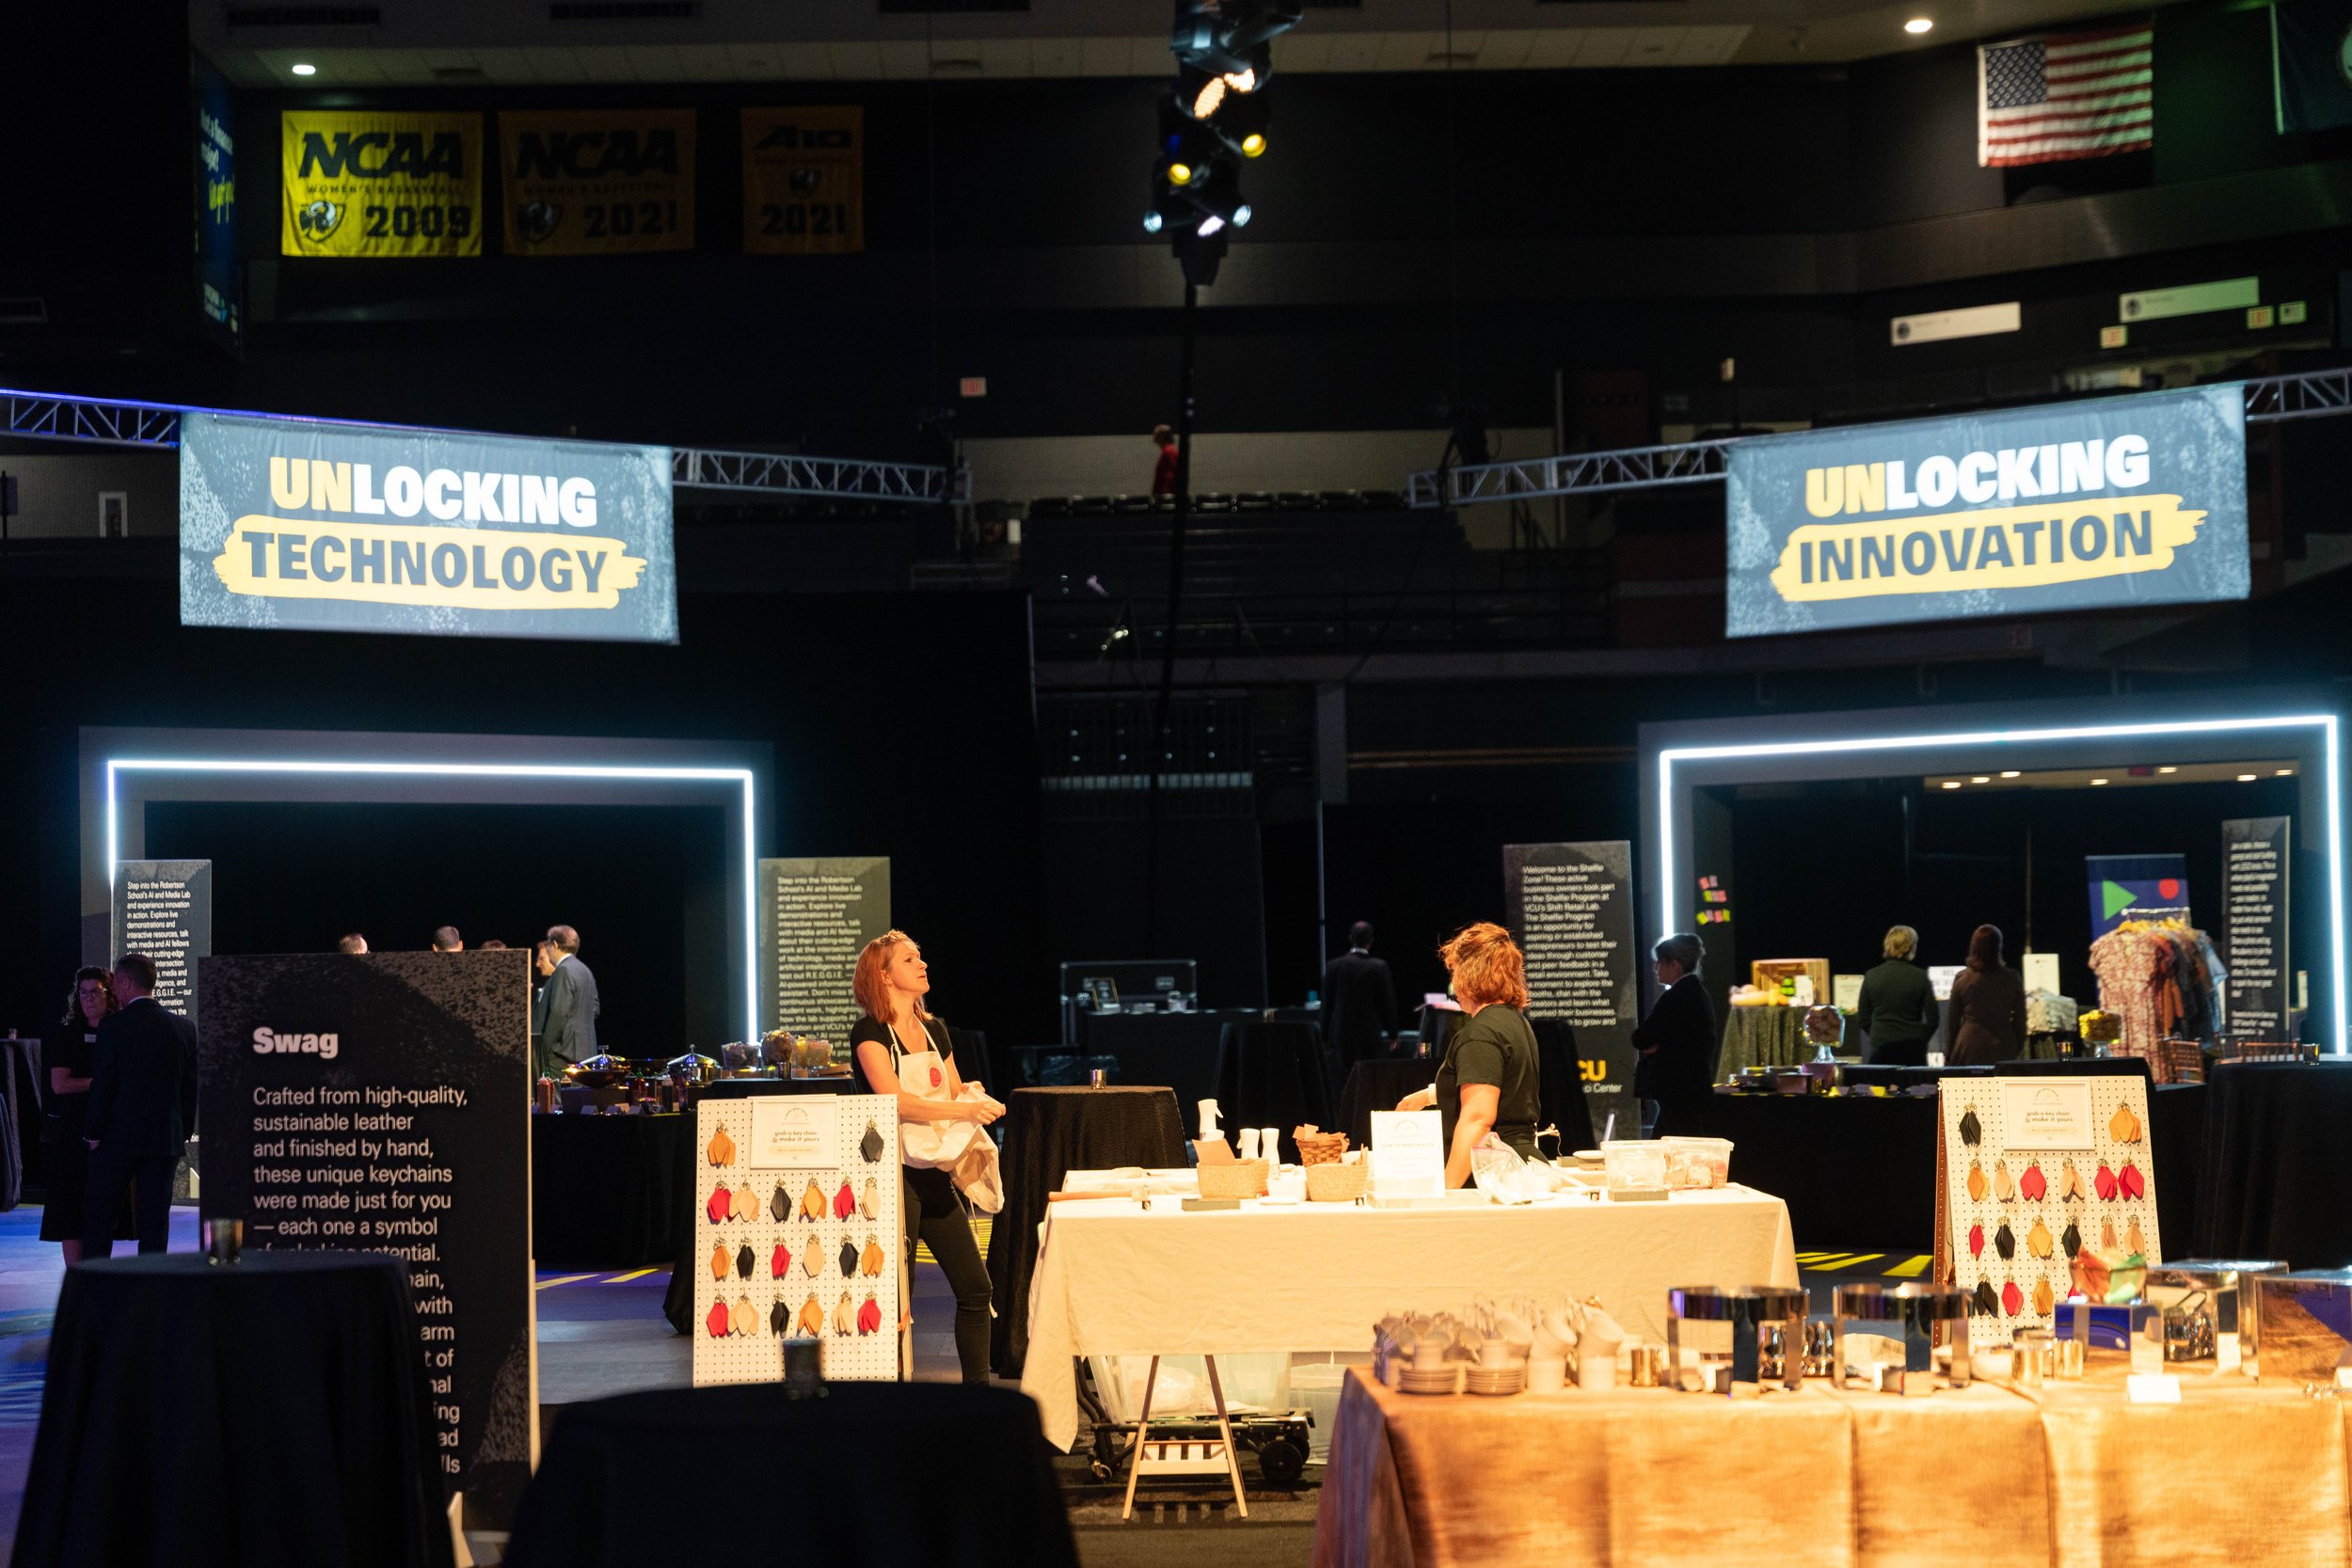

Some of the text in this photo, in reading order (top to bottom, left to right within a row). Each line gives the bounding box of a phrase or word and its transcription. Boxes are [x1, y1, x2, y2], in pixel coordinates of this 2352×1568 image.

[297, 132, 465, 179] NCAA
[516, 129, 678, 179] NCAA
[365, 205, 472, 239] 2009
[584, 201, 679, 239] 2021
[761, 204, 848, 236] 2021
[1804, 434, 2151, 518] UNLOCKING
[269, 456, 598, 528] UNLOCKING
[1798, 509, 2153, 584] INNOVATION
[241, 531, 609, 594] TECHNOLOGY
[1522, 866, 1556, 875] Welcome
[1566, 864, 1579, 874] the
[1579, 863, 1604, 873] Shelfie
[1523, 874, 1588, 884] Zone! These active
[127, 881, 139, 891] Step
[160, 880, 185, 889] Robertson
[127, 891, 148, 900] School's
[154, 891, 165, 899] and
[165, 891, 181, 899] Media
[181, 890, 191, 898] Lab
[1523, 884, 1555, 894] business
[1583, 883, 1599, 892] took
[1600, 883, 1615, 893] part
[127, 900, 190, 911] and experience innovation
[1533, 894, 1544, 902] the
[1545, 894, 1570, 902] Shelfie
[1570, 893, 1601, 903] Program
[1601, 893, 1610, 901] at
[127, 921, 166, 929] demonstrations
[151, 911, 168, 920] Explore
[1525, 911, 1595, 923] The Shelfie Program
[127, 929, 189, 940] interactive resources, talk
[139, 941, 154, 949] media
[155, 940, 165, 948] and
[171, 940, 190, 948] fellows
[153, 949, 185, 959] cutting-edge
[155, 959, 184, 968] intersection
[161, 969, 177, 977] media
[178, 968, 187, 976] and
[252, 1025, 339, 1060] Swag
[252, 1085, 468, 1108] Crafted from high-quality,
[1593, 1083, 1623, 1093] Center
[252, 1112, 414, 1132] sustainable leather
[252, 1137, 434, 1160] and finished by hand,
[253, 1164, 453, 1186] these unique keychains
[253, 1191, 452, 1212] were made just for you
[278, 1217, 318, 1236] each
[322, 1219, 355, 1236] one
[359, 1222, 371, 1236] a
[374, 1216, 438, 1239] symbol
[414, 1295, 453, 1315] with
[435, 1348, 455, 1368] of
